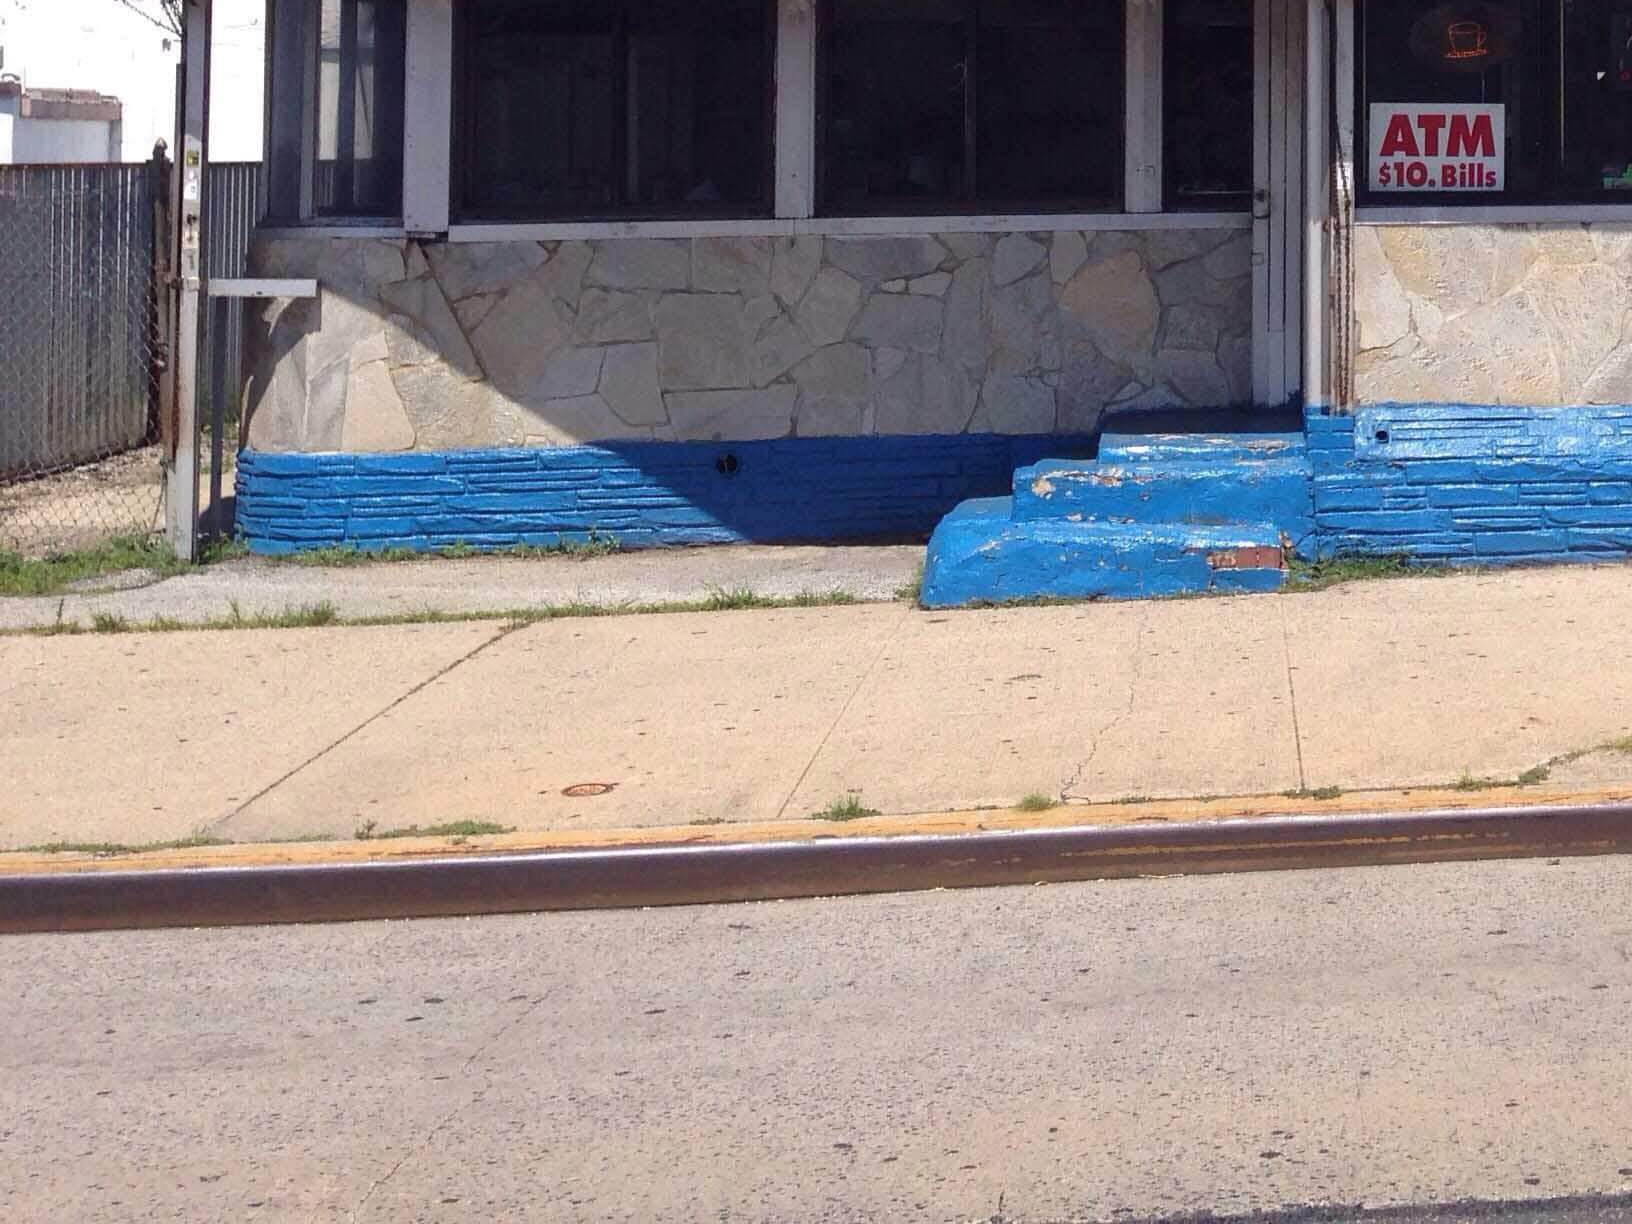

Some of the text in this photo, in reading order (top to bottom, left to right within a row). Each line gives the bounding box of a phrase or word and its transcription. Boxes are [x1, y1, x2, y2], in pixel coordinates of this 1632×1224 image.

[1379, 114, 1496, 157] ATM
[1378, 161, 1497, 188] $10. Bills
